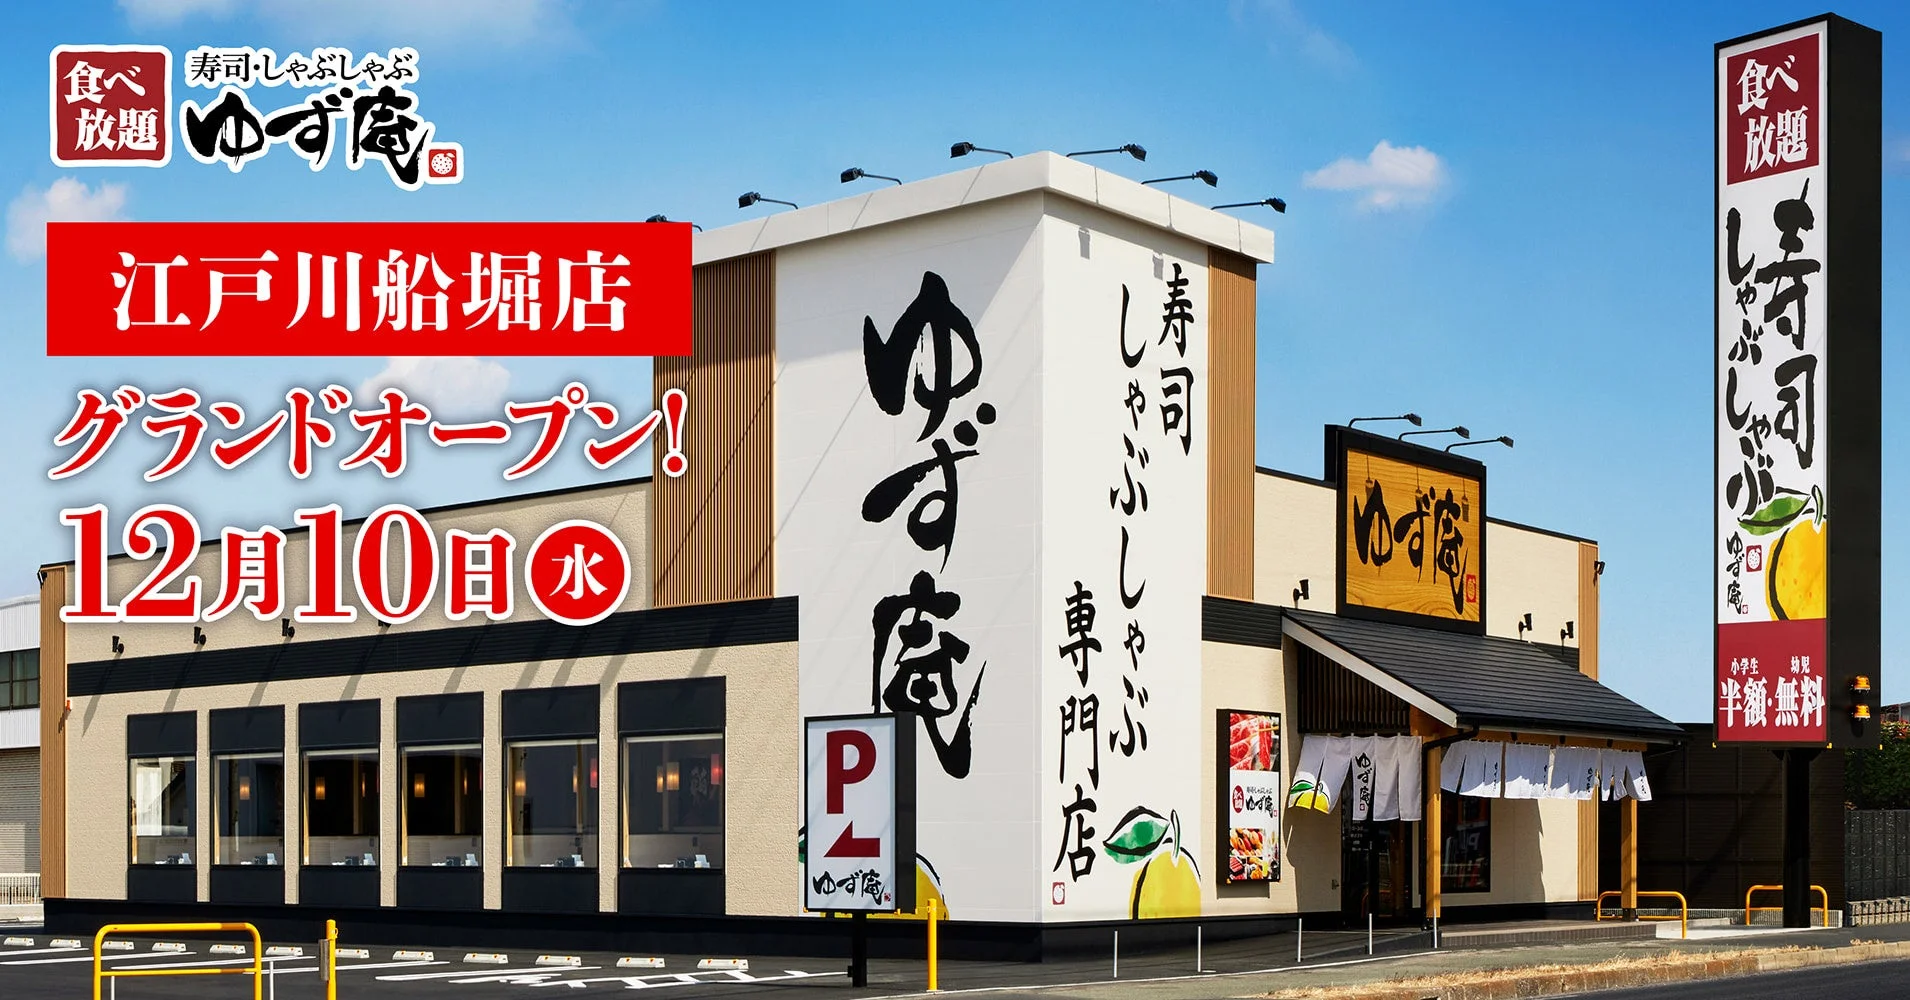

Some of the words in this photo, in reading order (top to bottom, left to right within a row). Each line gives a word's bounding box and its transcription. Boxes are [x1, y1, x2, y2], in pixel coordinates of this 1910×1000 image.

[1736, 55, 1799, 115] 食べ
[1744, 105, 1808, 173] 放題
[1158, 263, 1194, 455] 寿司
[1726, 208, 1774, 516] しゃぶしゃぶ
[1755, 178, 1821, 469] 寿司
[862, 271, 996, 779] ゆず庵
[1110, 284, 1149, 756] しゃぶしゃぶ
[1354, 479, 1468, 615] ゆず庵
[1726, 531, 1744, 614] ゆず庵
[1053, 581, 1101, 882] 専門店
[1731, 658, 1759, 675] 小学生
[1791, 656, 1810, 674] 幼児
[826, 730, 876, 814] P
[813, 869, 884, 905] ゆず庵
